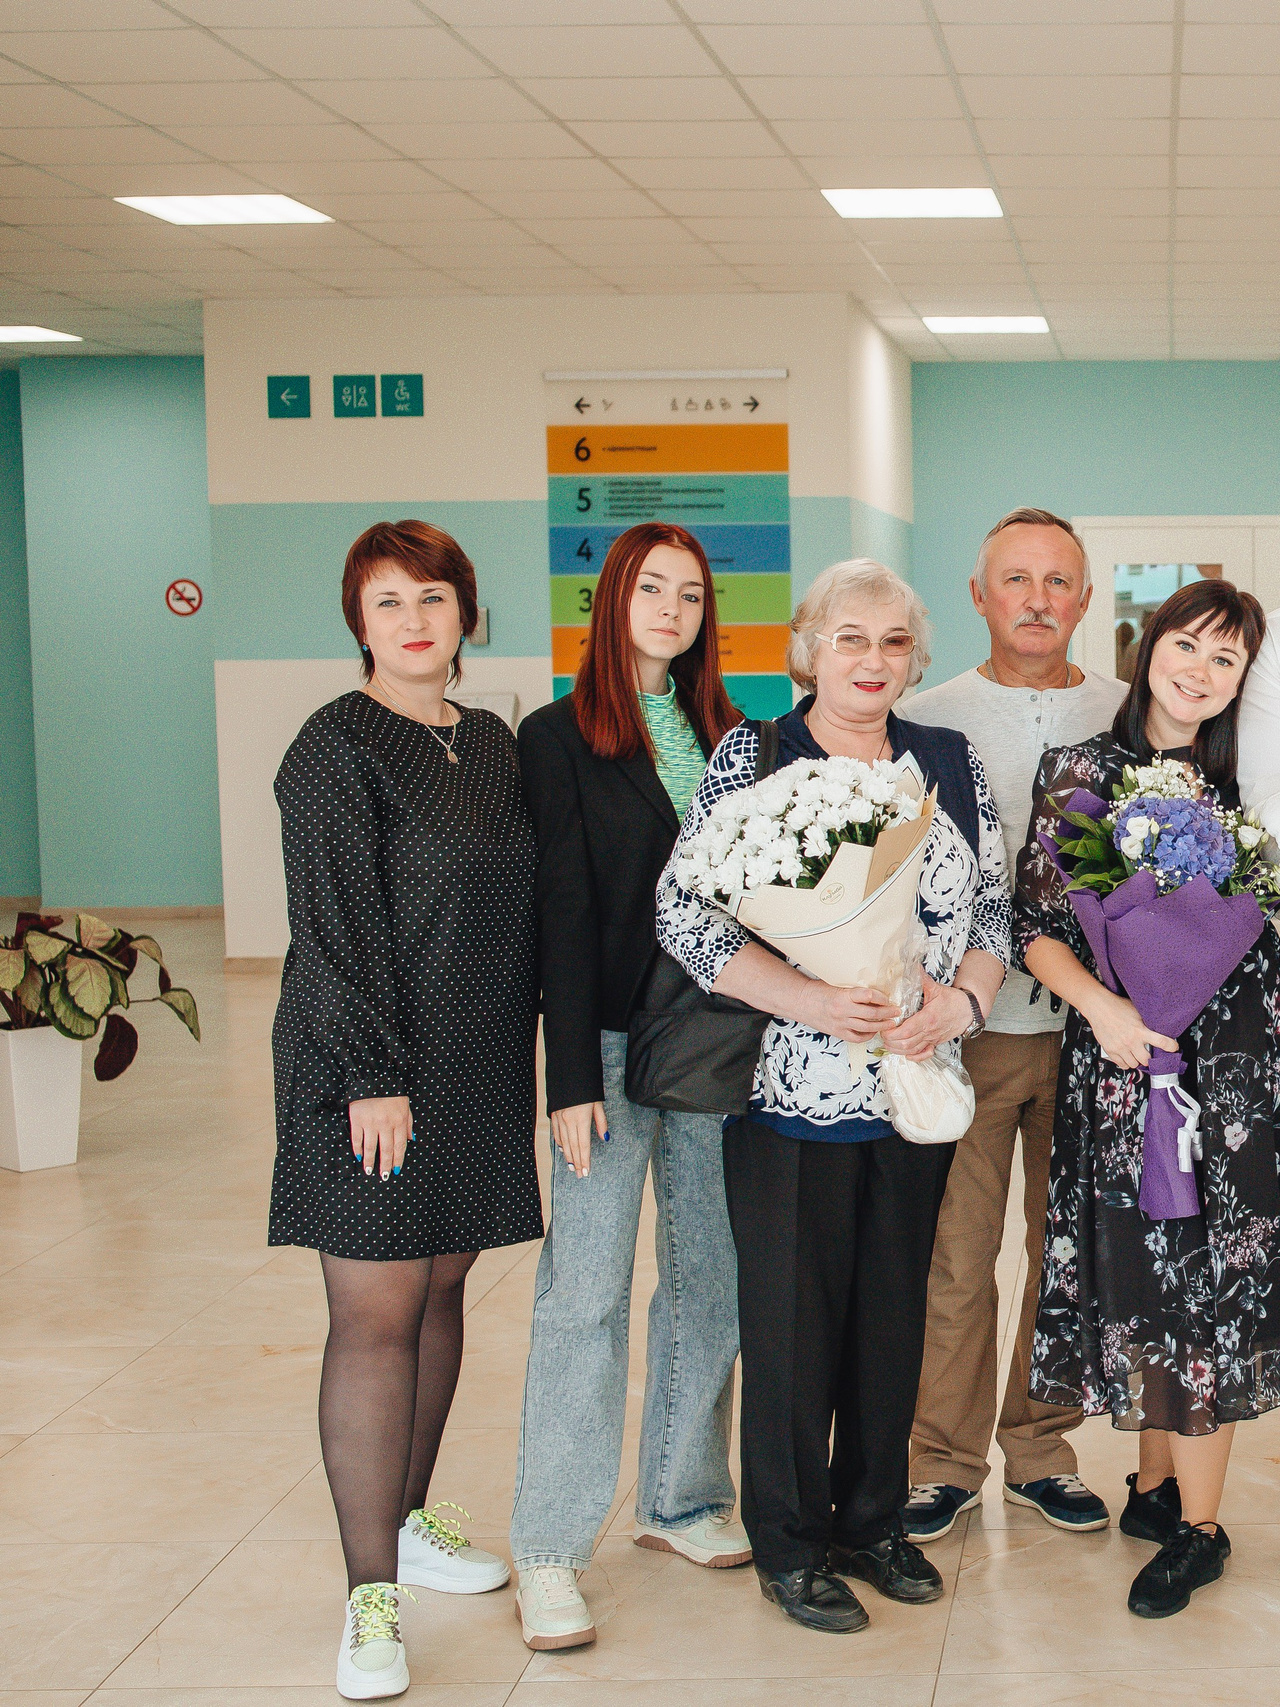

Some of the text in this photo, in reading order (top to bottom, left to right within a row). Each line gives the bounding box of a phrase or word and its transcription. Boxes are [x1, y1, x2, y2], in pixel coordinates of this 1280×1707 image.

[574, 436, 591, 462] 6
[576, 487, 591, 513] 5
[576, 537, 593, 563] 4
[578, 587, 593, 613] 3
